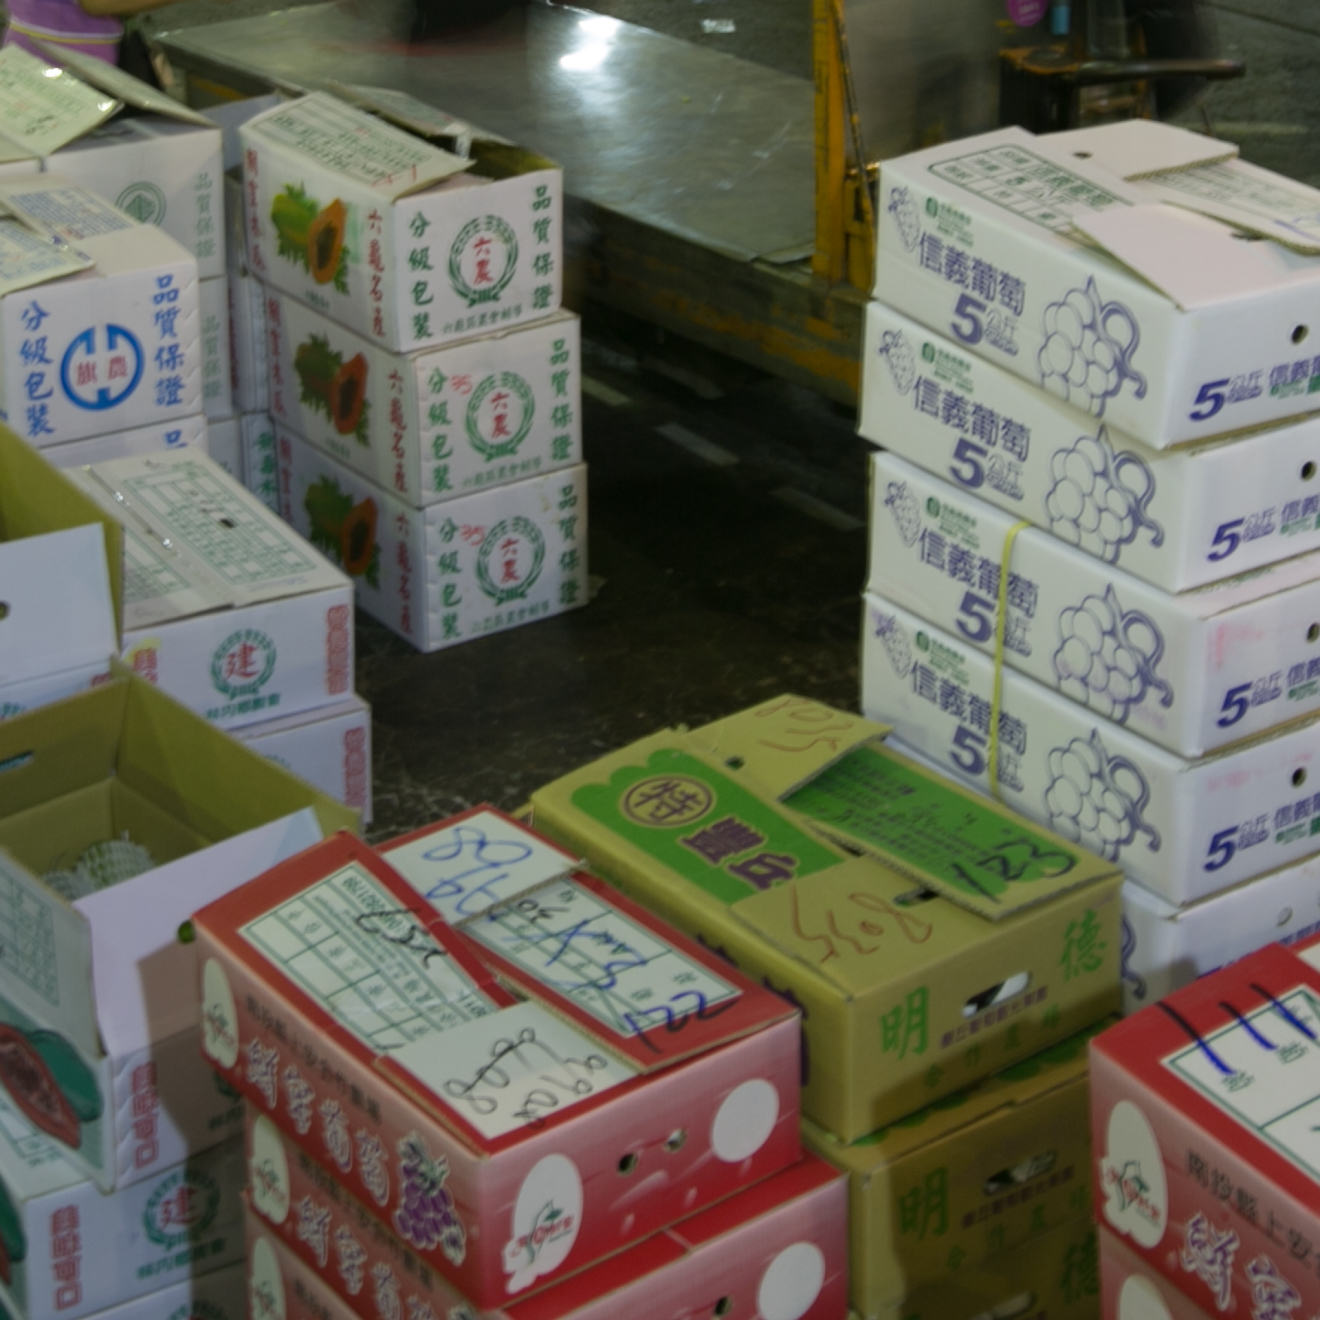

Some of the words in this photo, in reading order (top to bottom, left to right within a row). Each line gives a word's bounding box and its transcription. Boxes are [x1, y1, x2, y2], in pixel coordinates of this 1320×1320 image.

[408, 211, 435, 341] 分級包裝
[531, 183, 555, 311] 品質保證
[918, 230, 1027, 317] 信義葡萄
[152, 273, 185, 408] 品質保證
[950, 292, 988, 345] 5
[19, 300, 56, 437] 分級包裝
[548, 338, 573, 461] 品質保證
[1188, 376, 1230, 421] 5
[428, 366, 454, 493] 分級包裝
[914, 374, 1031, 463] 信義葡萄
[949, 436, 989, 489] 5
[438, 516, 463, 640] 分級包裝
[557, 483, 580, 606] 品質保證
[919, 527, 1040, 619] 信義葡萄
[1207, 516, 1246, 562] 5
[955, 590, 996, 644] 5
[223, 643, 263, 680] 建
[1216, 681, 1253, 729] 5
[910, 659, 1028, 756] 信義葡萄
[949, 725, 988, 777] 5
[630, 777, 710, 826] 特
[680, 814, 800, 891] 豐丘
[950, 840, 1078, 905] 123
[1203, 824, 1240, 872] 5
[880, 985, 930, 1061] 明
[1059, 909, 1107, 981] 德
[131, 1060, 160, 1170] 美味可口
[898, 1166, 950, 1242] 明
